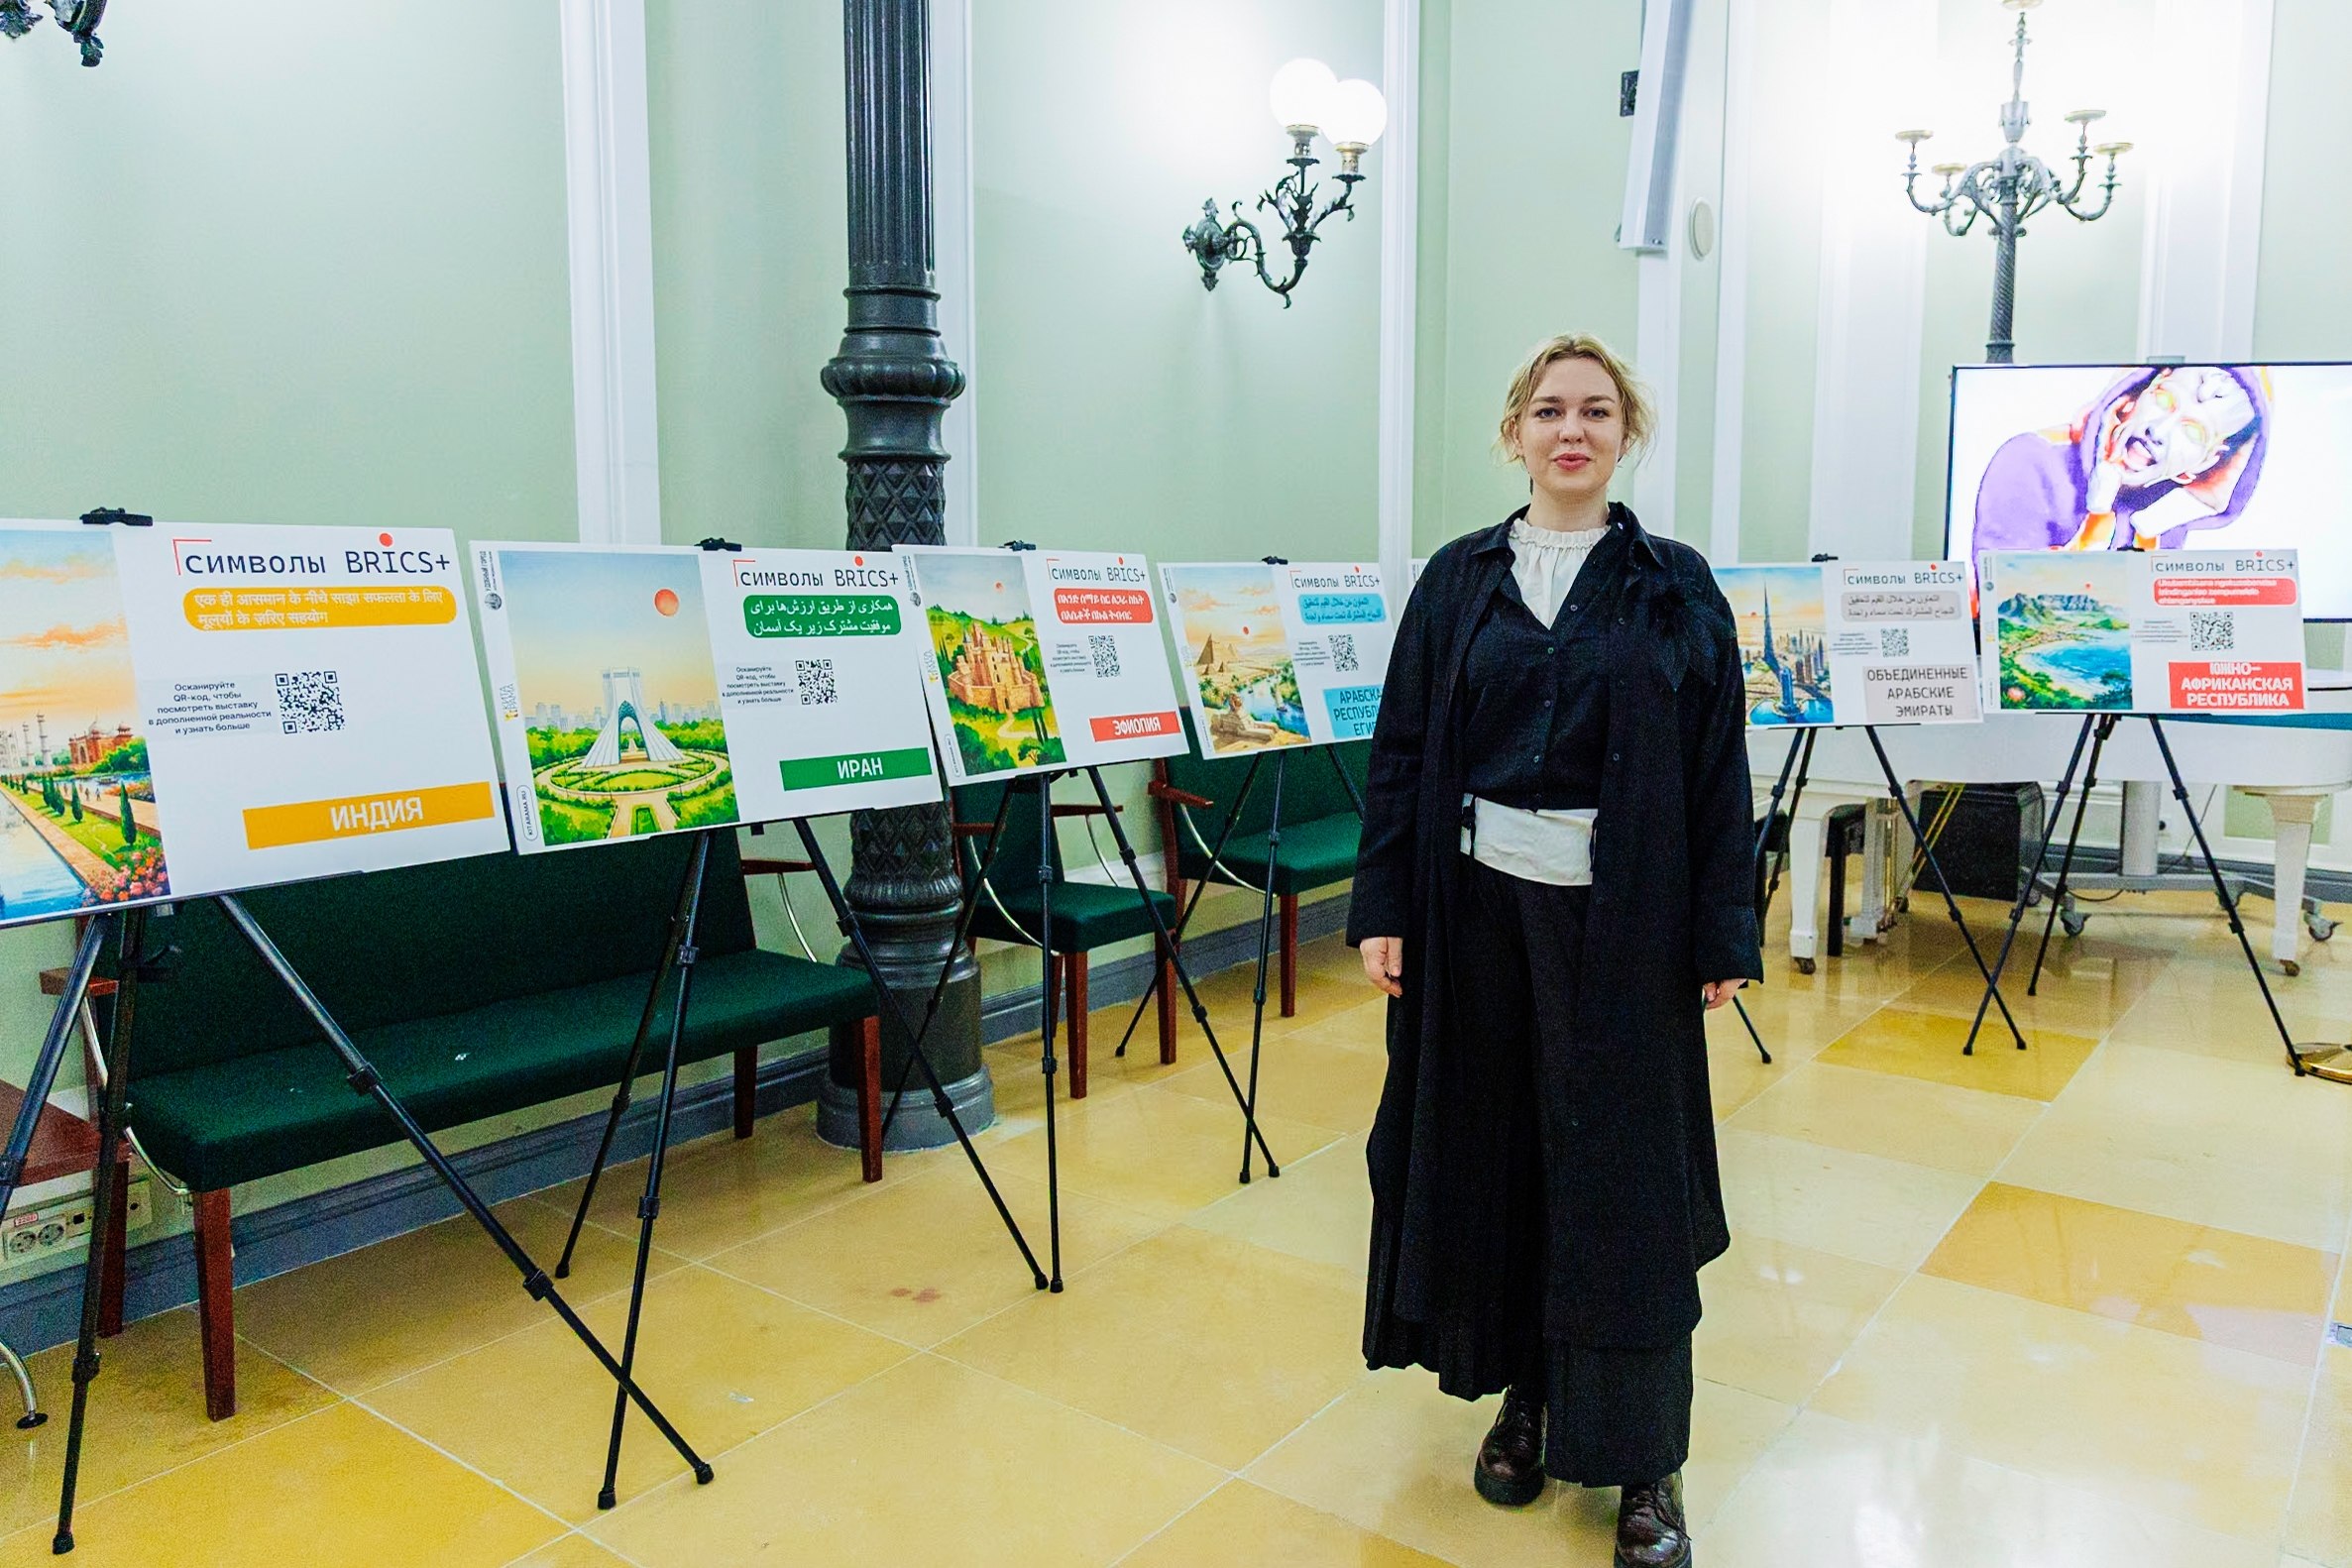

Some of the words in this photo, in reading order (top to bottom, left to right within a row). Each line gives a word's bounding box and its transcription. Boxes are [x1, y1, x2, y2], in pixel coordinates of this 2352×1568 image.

[185, 554, 326, 574] символы
[345, 548, 450, 574] BRICS+
[2235, 559, 2295, 572] BRICS+
[740, 572, 824, 587] символы
[835, 569, 899, 588] BRICS+
[1106, 566, 1146, 583] BRICS+
[1344, 574, 1381, 588] BRICS+
[1914, 572, 1963, 585] BRICS+
[818, 599, 844, 616] طریق
[858, 600, 893, 616] همکاری
[1867, 667, 1968, 682] ОБЪЕДИНЕННЫЕ
[2182, 677, 2294, 691] АФРИКАНСКАЯ
[1340, 688, 1383, 704] АРАБСКА
[1887, 686, 1955, 700] АРАБСКИЕ
[2186, 693, 2291, 707] РЕСПУБЛИКА
[157, 705, 214, 715] посмотреть
[215, 701, 258, 711] выставку
[1333, 705, 1379, 722] РЕСПУБЛ
[1895, 705, 1954, 718] ЭМИРАТЫ
[219, 710, 272, 722] реальности
[183, 725, 214, 735] узнать
[215, 723, 251, 732] больше
[1112, 717, 1162, 735] ЭФИОПИЯ
[837, 756, 884, 780] ИРАН
[330, 796, 424, 833] ИНДИЯ
